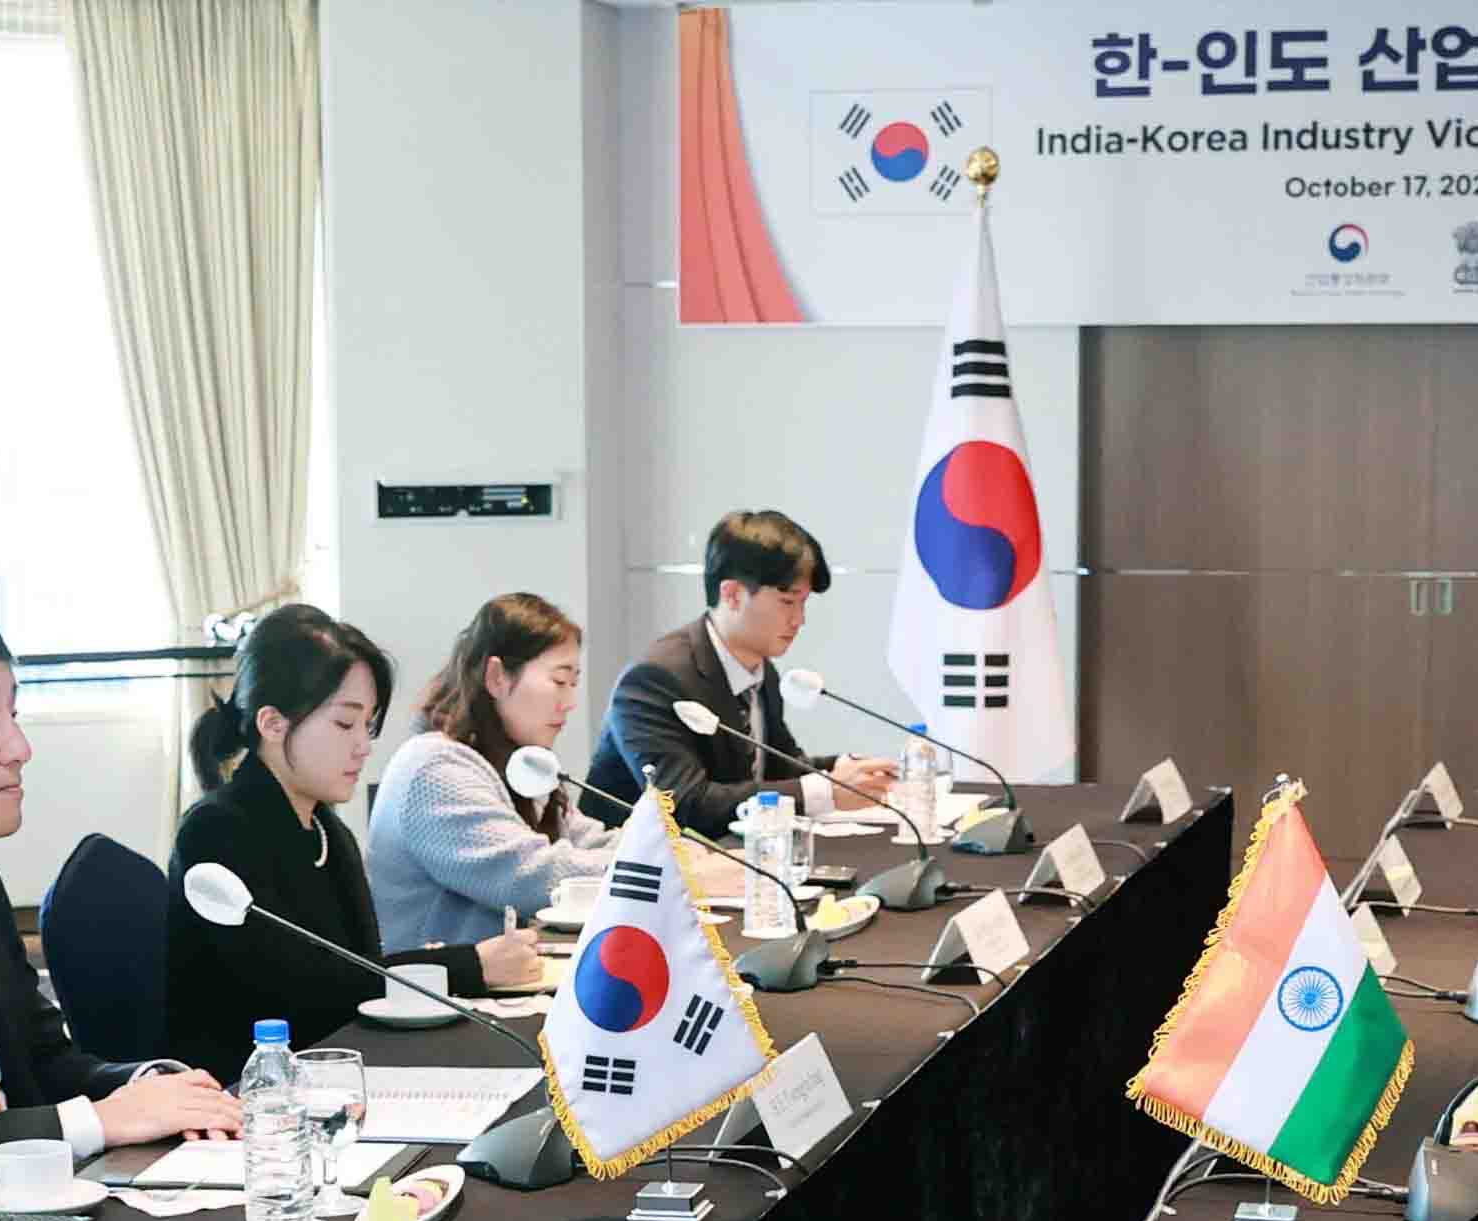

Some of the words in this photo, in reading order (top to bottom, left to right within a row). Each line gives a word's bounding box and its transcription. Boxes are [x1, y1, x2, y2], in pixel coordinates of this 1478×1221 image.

[1091, 31, 1331, 98] 한-인도
[1036, 124, 1249, 156] India-Korea
[1261, 119, 1415, 156] Industry
[1284, 175, 1397, 199] October
[1402, 174, 1433, 199] 17,
